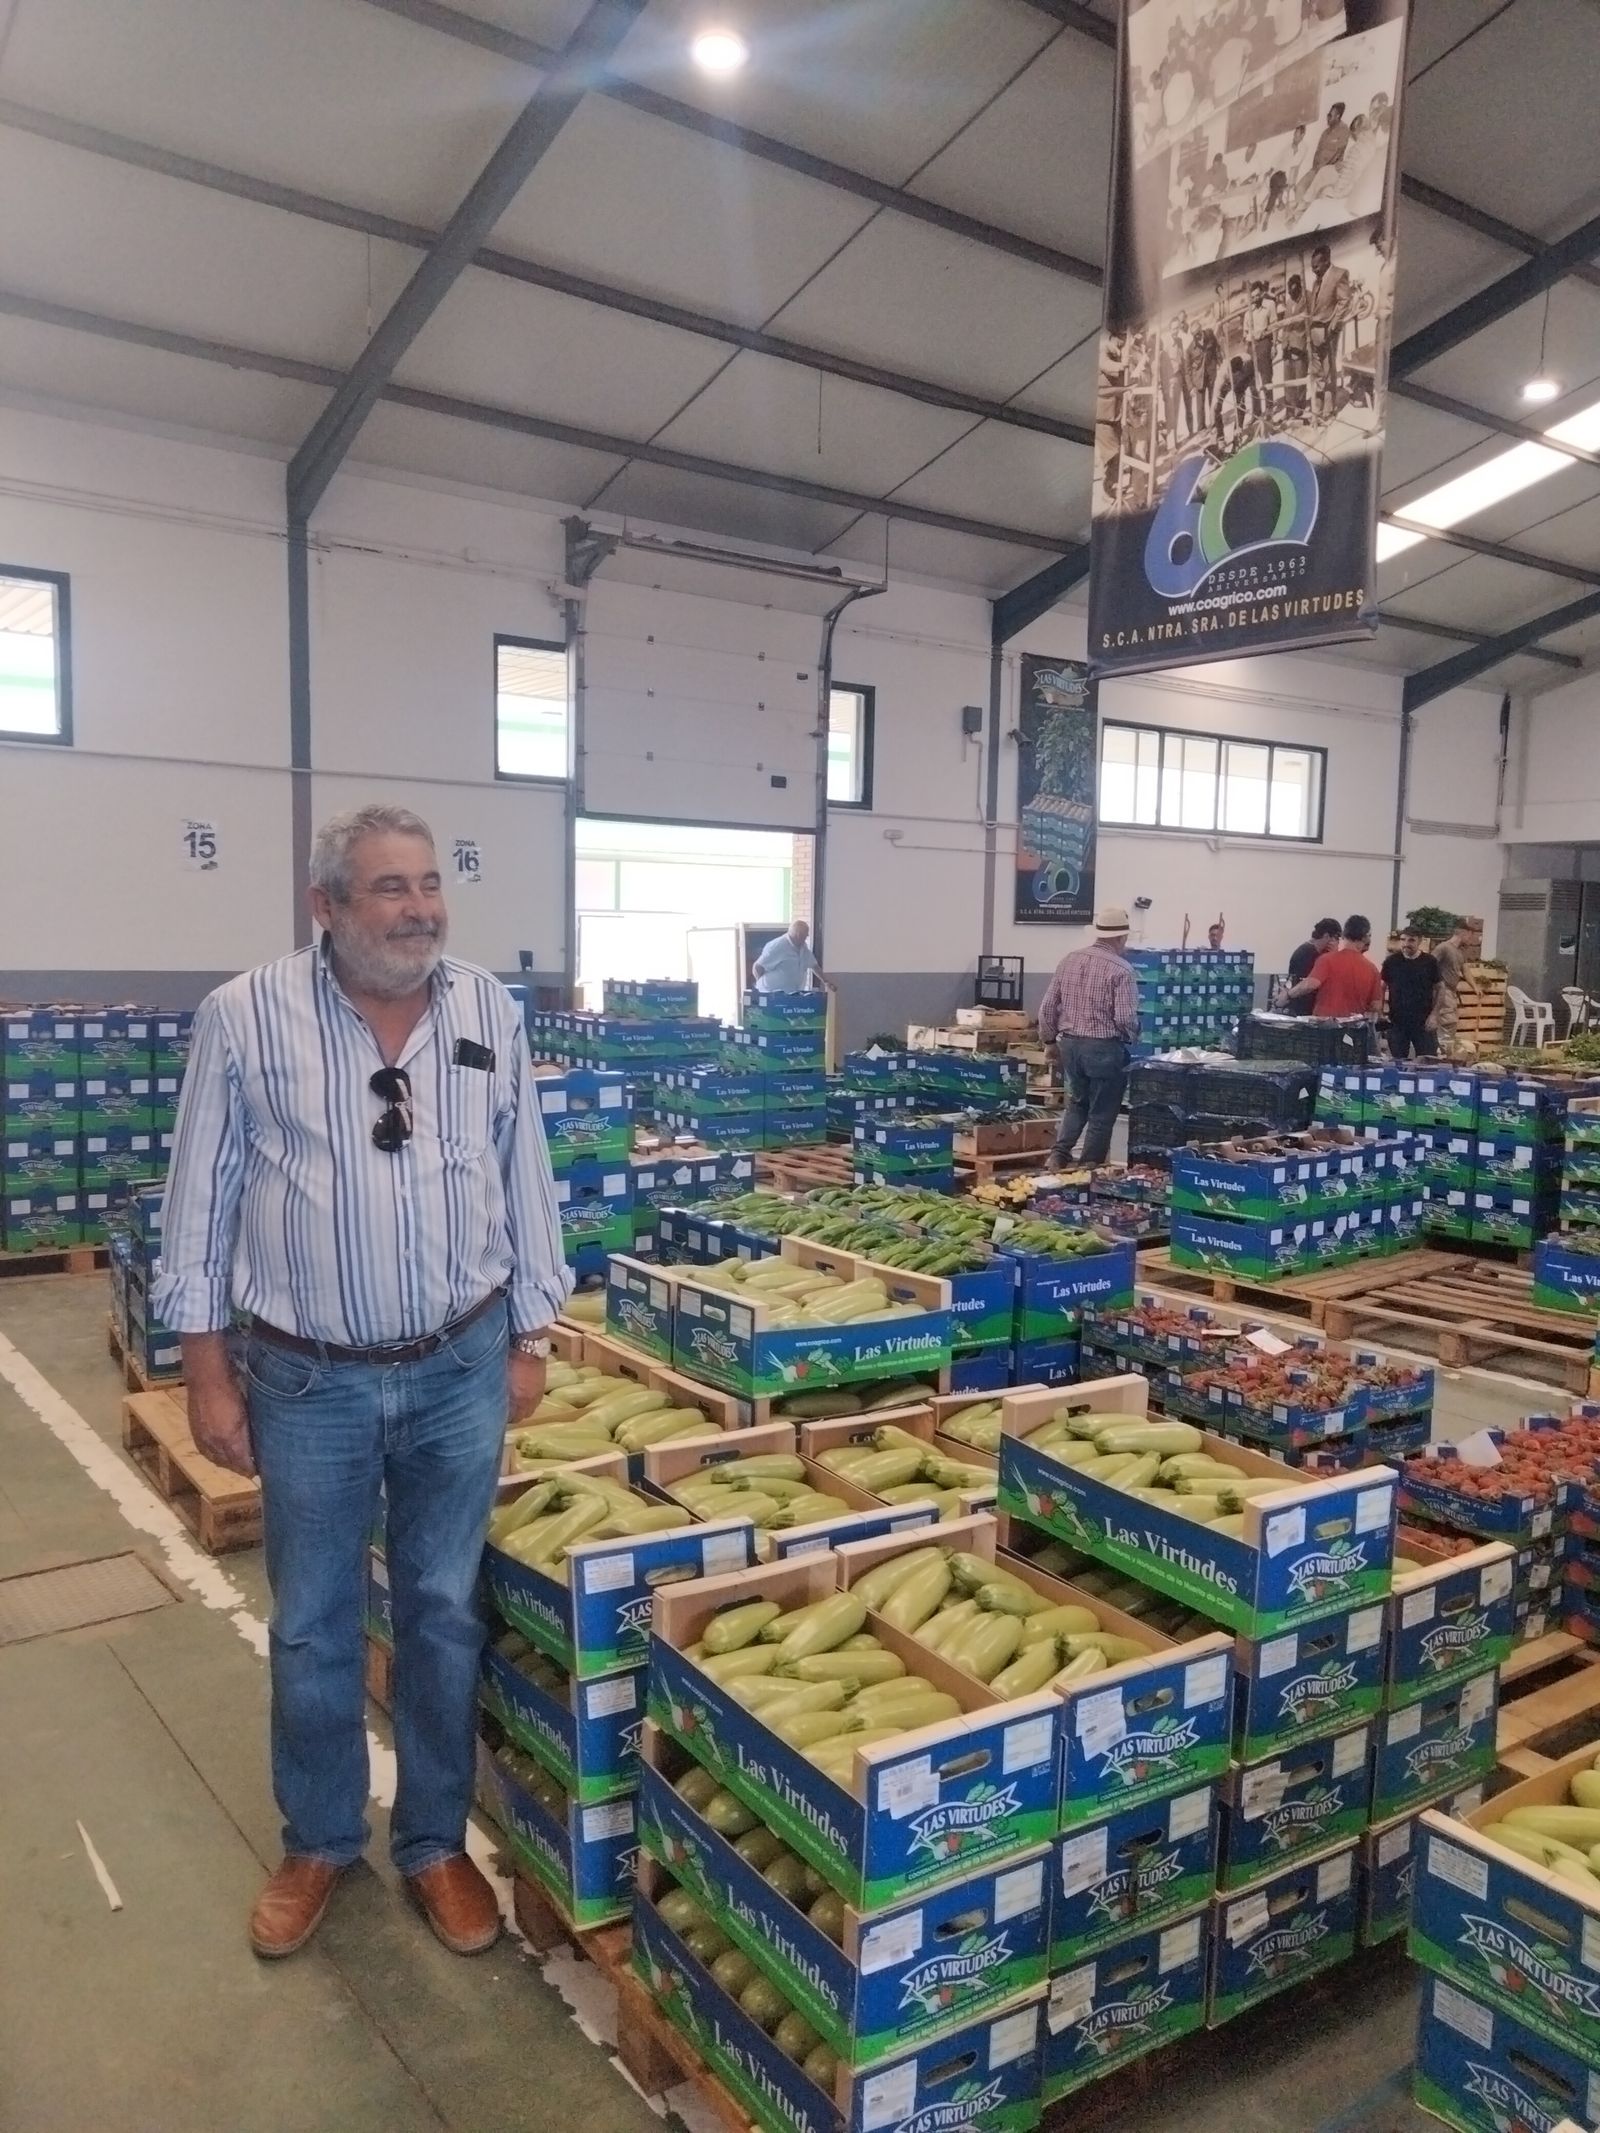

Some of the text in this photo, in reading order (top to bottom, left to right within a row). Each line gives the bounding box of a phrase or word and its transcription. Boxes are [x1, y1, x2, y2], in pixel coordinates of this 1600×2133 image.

[1208, 556, 1306, 585] DESDE 1963
[1208, 567, 1306, 593] ANIVERSARIO
[1168, 584, 1288, 617] www.coagrico.com
[1102, 629, 1144, 649] S.C.A.
[1148, 622, 1188, 641] NTRA.
[1191, 615, 1224, 634] SRA.
[1284, 588, 1364, 618] VIRTUDES
[187, 821, 213, 830] ZONA
[183, 831, 217, 859] 15
[455, 839, 476, 848] ZONA
[452, 849, 480, 873] 16
[562, 1121, 606, 1131] LAS VIRTUDES
[1194, 1176, 1246, 1193] Las Virtudes
[566, 1209, 610, 1220] LAS VIRTUDES
[1191, 1233, 1242, 1252] Las Virtudes
[1052, 1286, 1071, 1299] Las
[1072, 1278, 1112, 1294] Virtudes
[1564, 1271, 1583, 1284] Las
[951, 1297, 986, 1313] rtudes
[697, 1331, 708, 1344] LAS
[854, 1344, 881, 1363] Las
[885, 1332, 942, 1355] Virtudes
[1049, 1367, 1067, 1380] Las
[1103, 1516, 1238, 1595] Las Virtudes
[1298, 1552, 1358, 1582] LAS VIRTUDES
[505, 1581, 522, 1604] Las
[522, 1587, 566, 1635] Virtudes
[631, 1602, 652, 1622] LAS
[1429, 1624, 1482, 1650] LAS VIRTUDES
[1290, 1673, 1348, 1703] LAS VIRTUDES
[513, 1696, 572, 1763] Las Virtudes
[1114, 1729, 1187, 1763] LAS VIRTUDES
[1414, 1737, 1467, 1767] LAS VIRTUDES
[737, 1742, 767, 1785] Las
[770, 1765, 848, 1857] Virtudes
[1272, 1799, 1334, 1830] LAS VIRTUDES
[923, 1797, 1006, 1838] LAS VIRTUDES
[1101, 1862, 1171, 1901] LAS VTUDES
[727, 1883, 757, 1929] Las
[760, 1910, 839, 2011] Virtudes
[1259, 1937, 1276, 1960] LAS
[914, 1946, 997, 1992] LAS VIRTUDES
[1478, 1925, 1583, 2006] LAS VIRTUDES
[1089, 1994, 1161, 2036] LAS VIRTUDES
[715, 2019, 742, 2067] Las
[747, 2051, 817, 2133] Virtud
[1483, 2075, 1510, 2101] LAS
[934, 2092, 991, 2127] VIRTUDES
